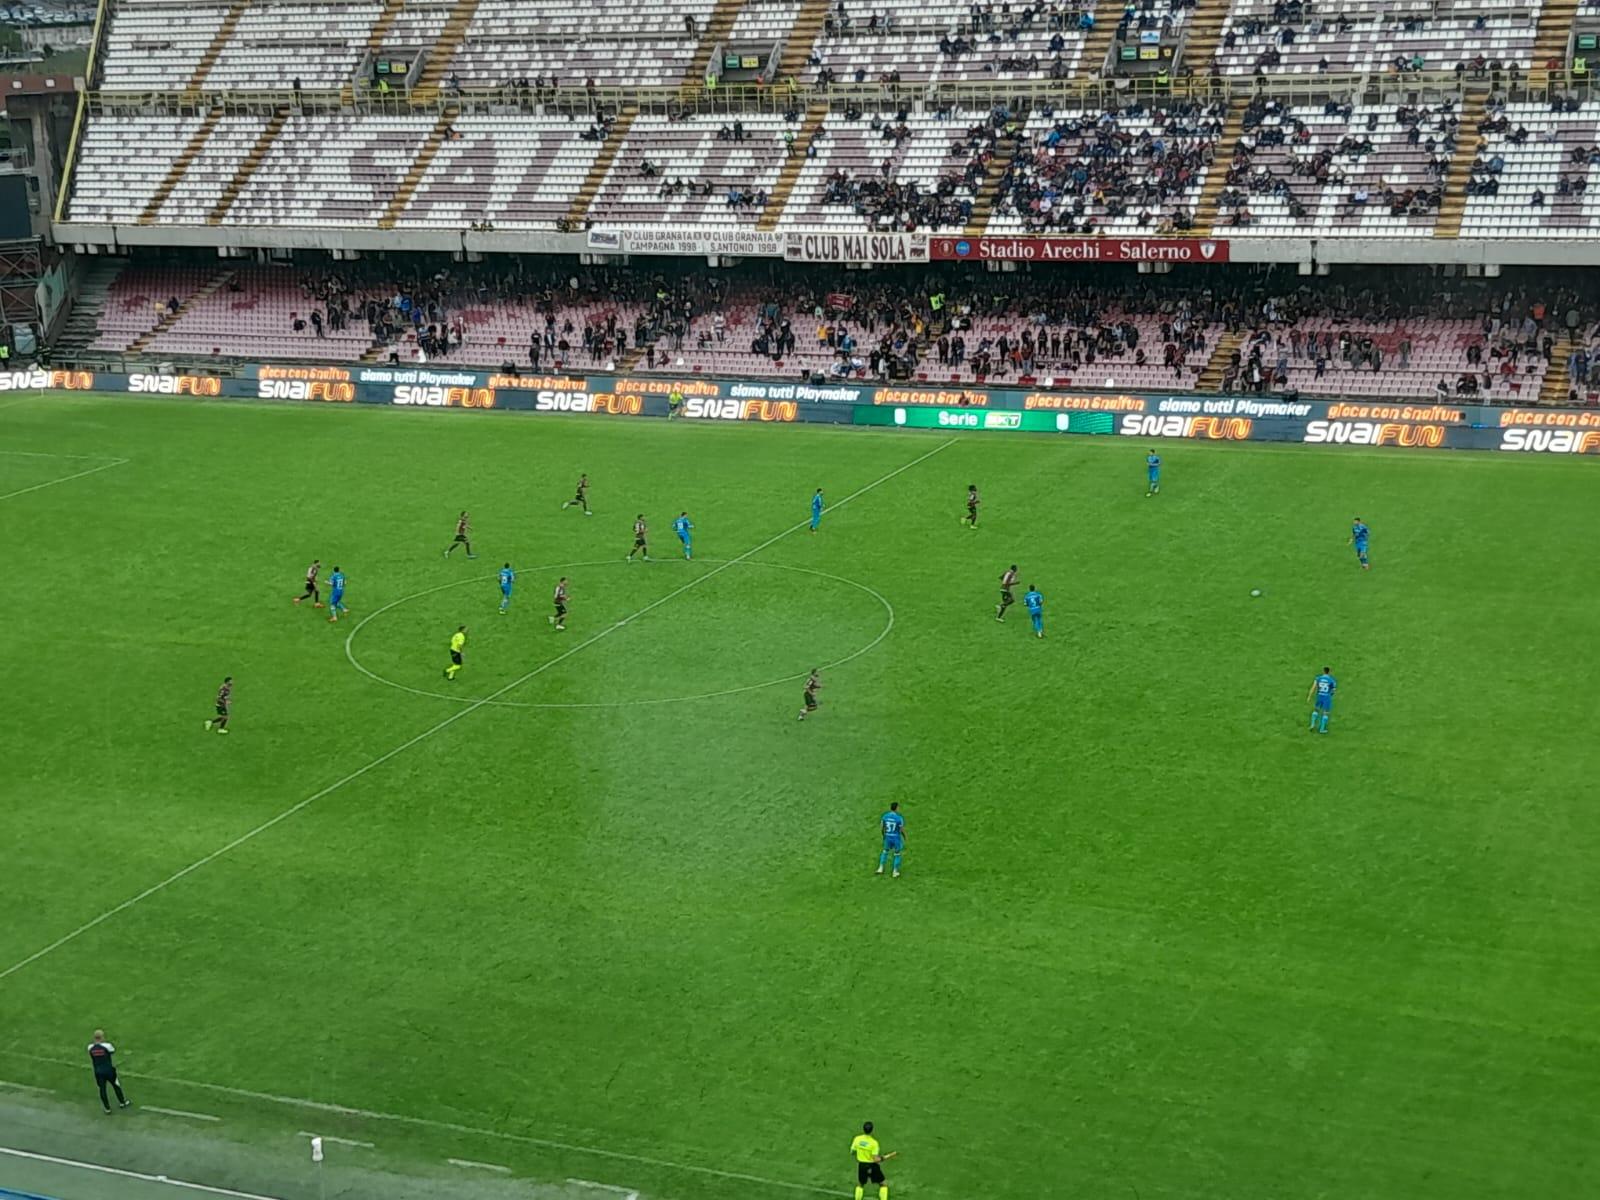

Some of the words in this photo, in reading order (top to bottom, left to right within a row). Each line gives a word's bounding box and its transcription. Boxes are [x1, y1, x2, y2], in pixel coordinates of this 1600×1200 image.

[633, 231, 654, 241] CLUB
[655, 231, 692, 241] GRANATA
[712, 232, 734, 242] CLUB
[735, 232, 774, 243] GRANATA
[630, 242, 675, 251] CAMPAGNA
[805, 235, 839, 260] CLUB
[843, 235, 868, 260] MAI
[871, 235, 906, 260] SOLA
[979, 241, 1035, 258] Stadio
[1041, 241, 1100, 259] Arechi
[1119, 243, 1191, 260] Salerno
[360, 369, 392, 382] siamo
[394, 370, 417, 383] tutti
[419, 371, 476, 386] Playmaker
[520, 376, 541, 389] con
[615, 379, 646, 394] gioca
[648, 382, 671, 393] con
[730, 383, 766, 397] siamo
[768, 384, 794, 398] tutti
[796, 386, 860, 402] Playmaker
[873, 387, 908, 405] gioca
[910, 391, 935, 404] con
[1025, 392, 1060, 410] gioca
[1063, 395, 1088, 408] con
[1158, 396, 1200, 413] siamo
[1203, 398, 1233, 413] tutti
[1235, 399, 1312, 417] Playmaker
[1328, 402, 1368, 419] gioca
[1371, 406, 1399, 419] con
[938, 411, 978, 426] Serie
[1501, 409, 1542, 427] gioca
[1546, 413, 1574, 426] con
[885, 821, 897, 832] 37
